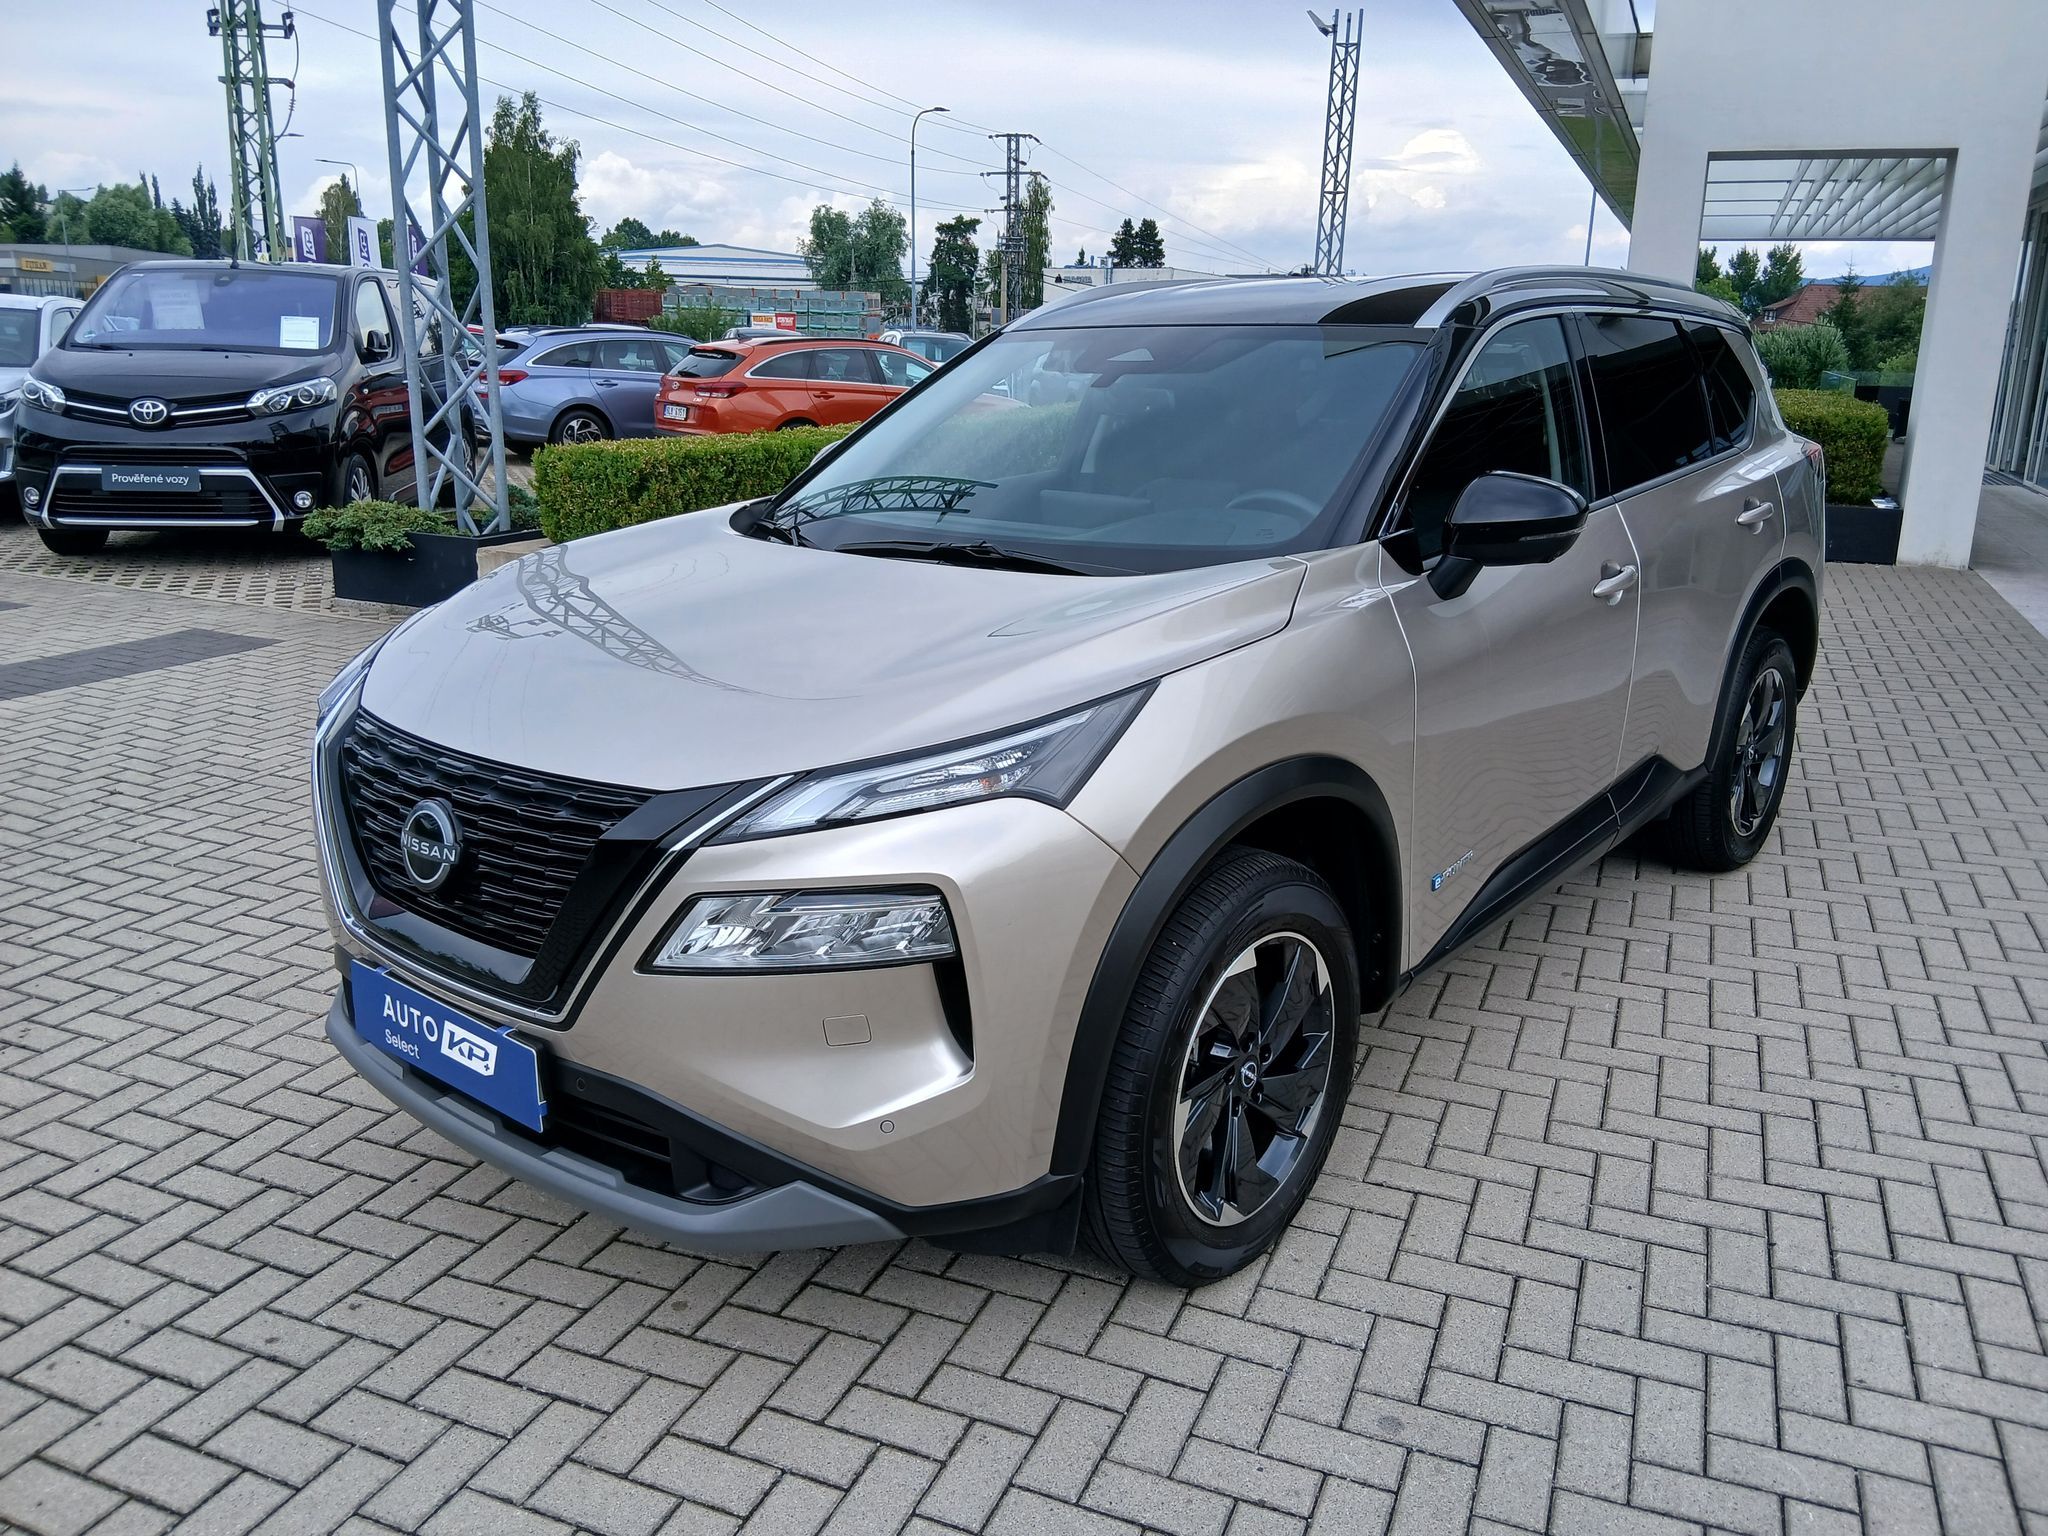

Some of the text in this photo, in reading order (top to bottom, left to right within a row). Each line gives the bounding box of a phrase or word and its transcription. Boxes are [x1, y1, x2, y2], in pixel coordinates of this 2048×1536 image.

[111, 472, 190, 486] Prověřené vozy
[401, 831, 456, 862] NISSAN
[383, 993, 439, 1042] AUTO
[384, 1028, 421, 1060] Select
